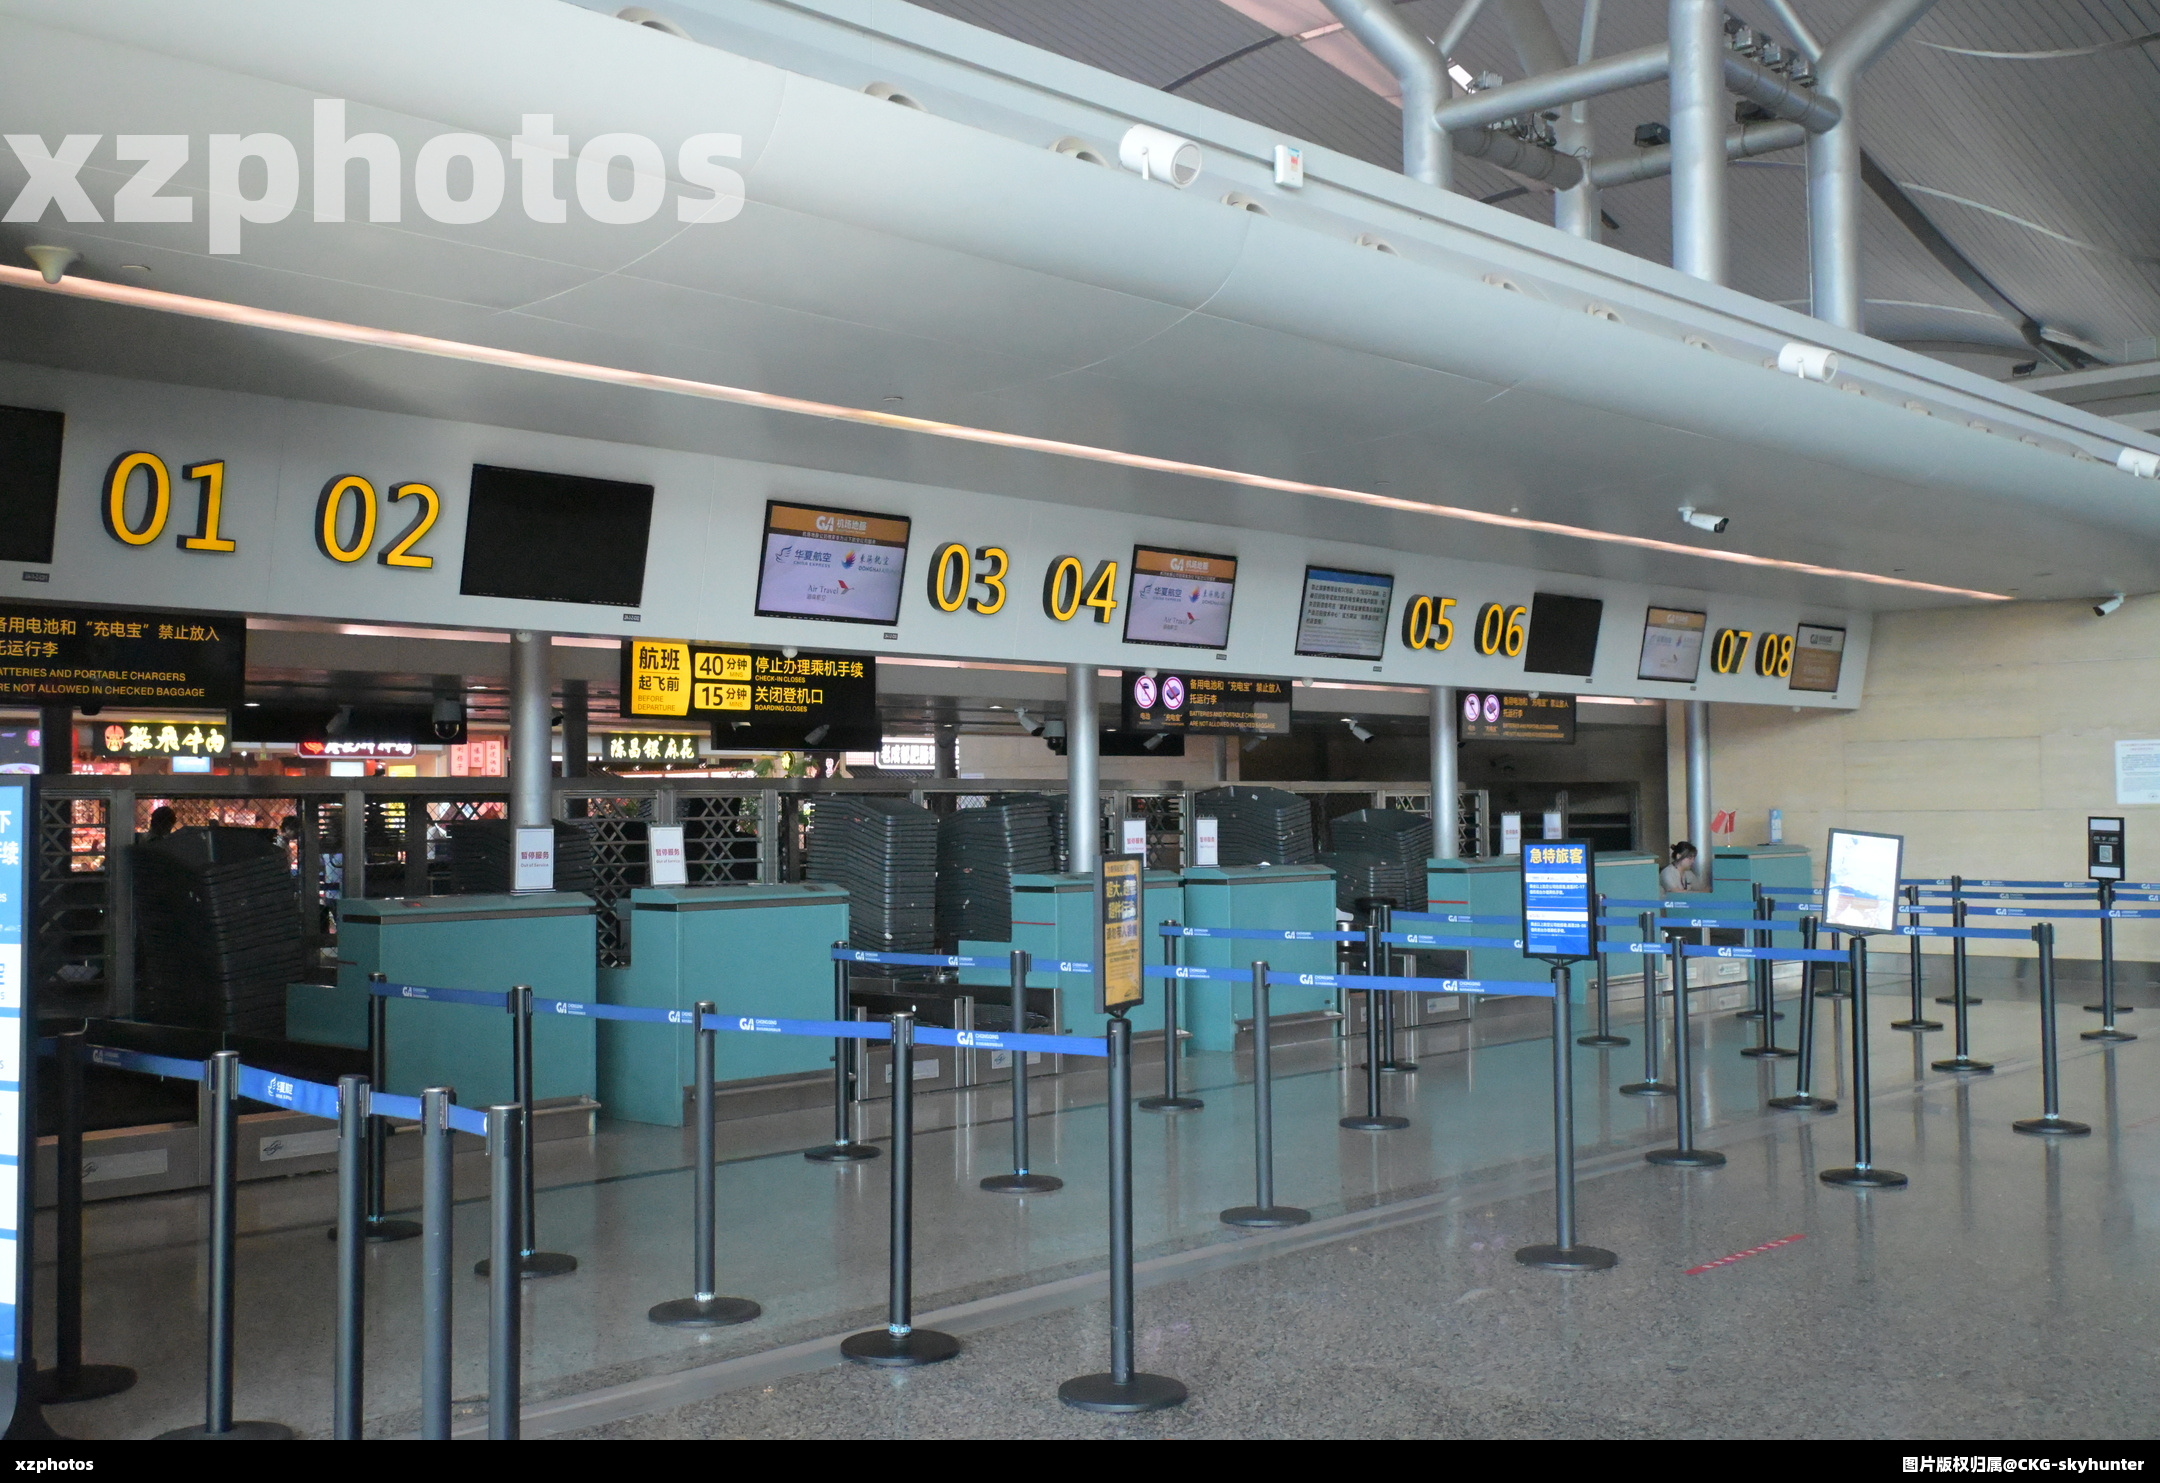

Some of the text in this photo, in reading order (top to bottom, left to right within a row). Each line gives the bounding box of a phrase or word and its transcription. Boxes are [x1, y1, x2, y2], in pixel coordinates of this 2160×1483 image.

[101, 449, 236, 553] 01
[315, 473, 441, 569] 02
[794, 549, 832, 562] 华夏航空
[927, 541, 1009, 615] 03
[808, 584, 838, 594] Air Travel
[1042, 554, 1118, 624] 04
[1402, 594, 1457, 651] 05
[1474, 602, 1527, 657] 06
[158, 624, 219, 642] 禁止放入
[638, 646, 680, 671] 航班
[1710, 628, 1753, 674] 07
[1755, 632, 1794, 678] 08
[49, 668, 72, 678] AND
[74, 670, 128, 680] PORTABLE
[130, 671, 186, 682] CHARGERS
[700, 656, 747, 676] 40 分钟
[755, 657, 864, 678] 停止办理乘机手续
[638, 675, 680, 692] 起飞前
[755, 674, 782, 683] CHECK-IN
[1190, 679, 1224, 690] 备用电池和
[1256, 683, 1281, 693] 禁止放入
[16, 683, 36, 693] NOT
[39, 684, 90, 694] ALLOWED
[92, 685, 102, 694] IN
[105, 686, 154, 696] CHECKED
[157, 687, 205, 697] BAGGAGE
[702, 686, 747, 707] 15 分钟
[755, 686, 823, 704] 关闭登机口
[1190, 693, 1218, 705] 托运行李
[637, 703, 676, 712] DEPARTURE
[521, 851, 549, 860] 暂停服务
[1530, 848, 1583, 864] 急特旅客
[739, 1018, 754, 1031] GA
[957, 1032, 973, 1045] GA
